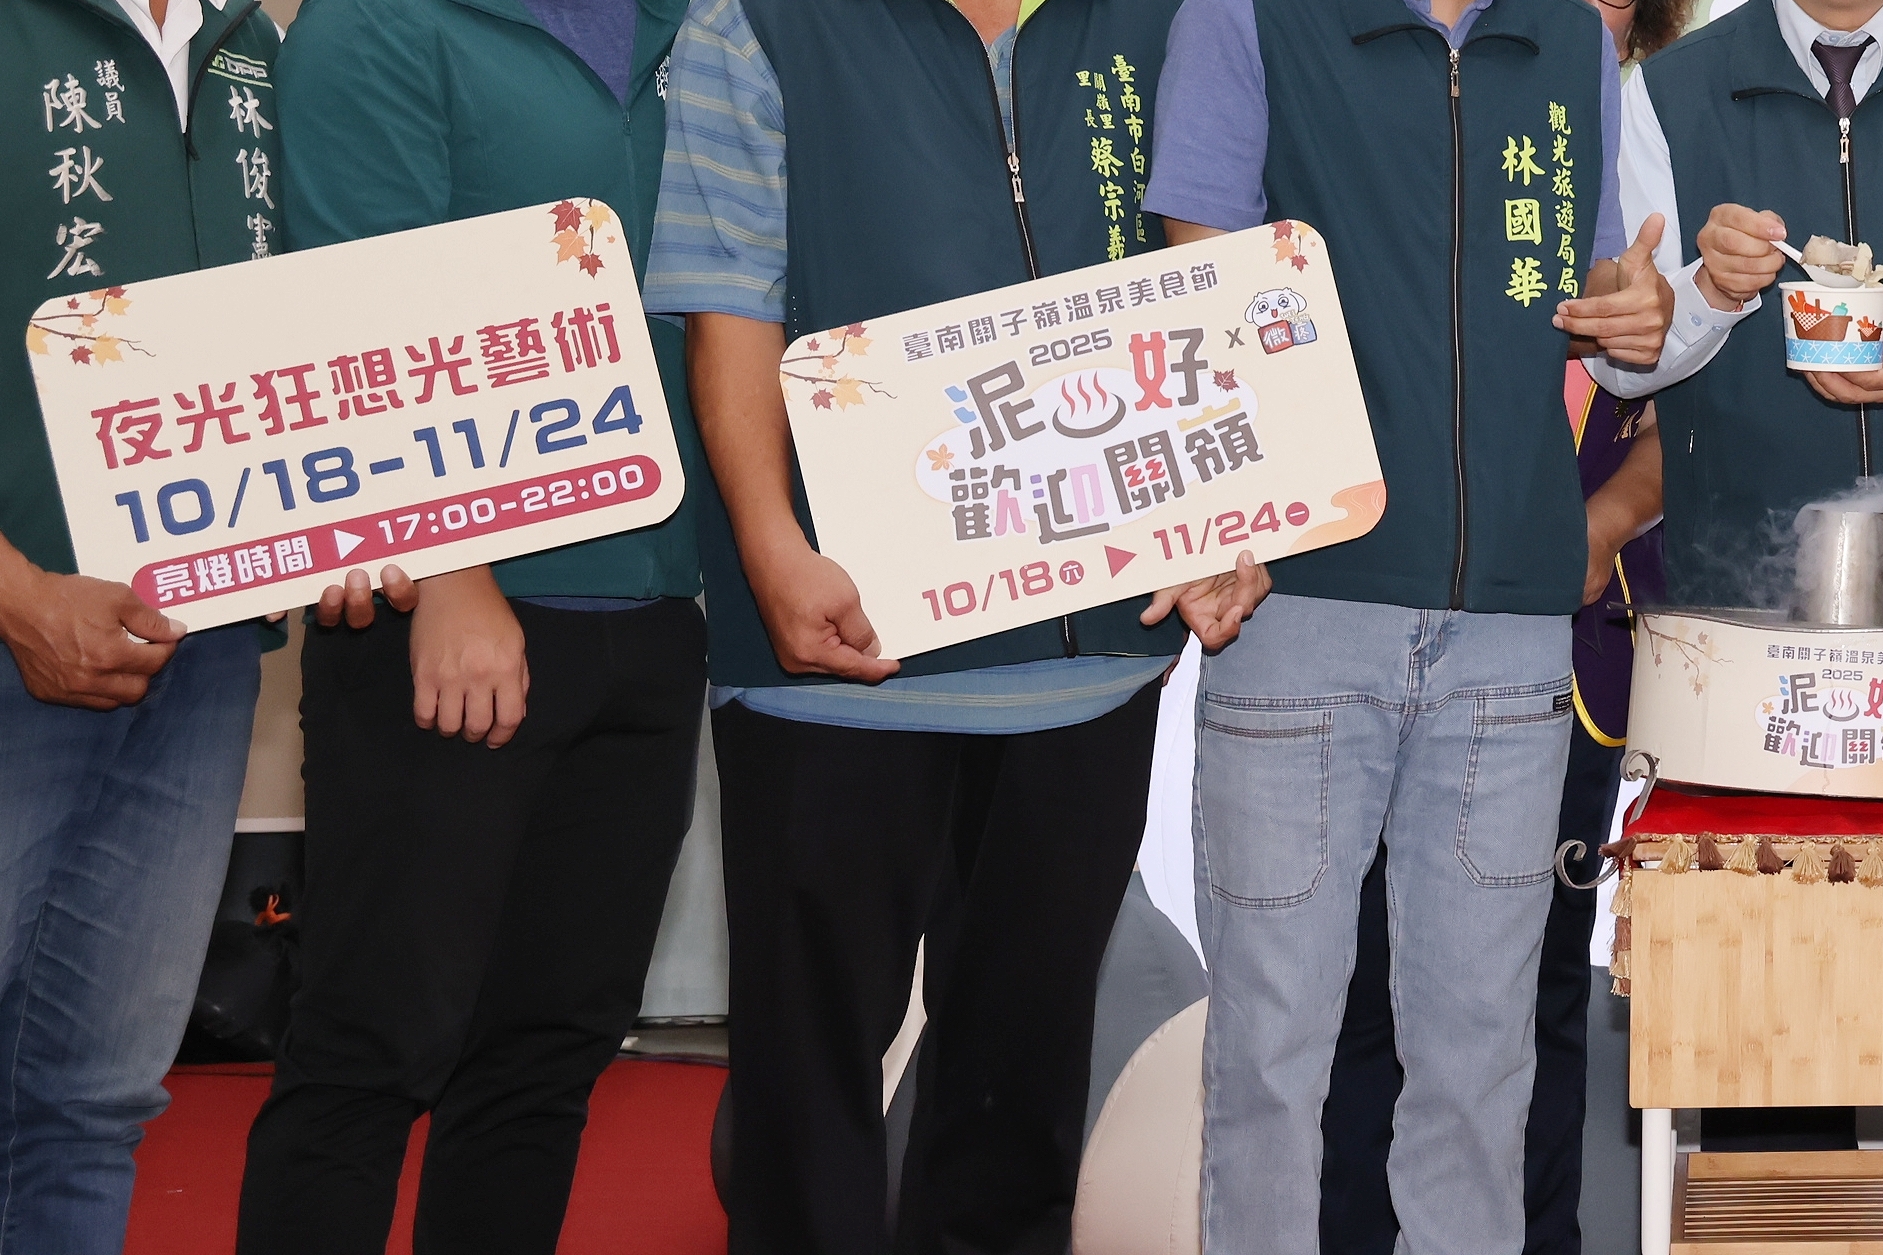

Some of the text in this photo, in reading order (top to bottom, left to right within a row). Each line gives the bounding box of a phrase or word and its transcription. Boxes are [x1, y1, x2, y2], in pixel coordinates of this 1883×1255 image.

[94, 59, 126, 124] 議員
[43, 73, 113, 280] 陳秋宏
[1090, 136, 1126, 262] 蔡宗義
[1501, 134, 1548, 308] 林國華
[1548, 101, 1579, 300] 觀光旅遊局局
[902, 262, 1218, 362] 臺南關子嶺溫泉美食節
[1029, 329, 1113, 366] 2025
[91, 302, 622, 471] 夜光狂想光藝術
[114, 385, 643, 543] 10/18-11/24
[152, 464, 645, 603] 亮燈時間 17:00-22:00
[922, 559, 1055, 622] 10/18
[1153, 501, 1281, 562] 11/24
[1821, 668, 1864, 681] 2025
